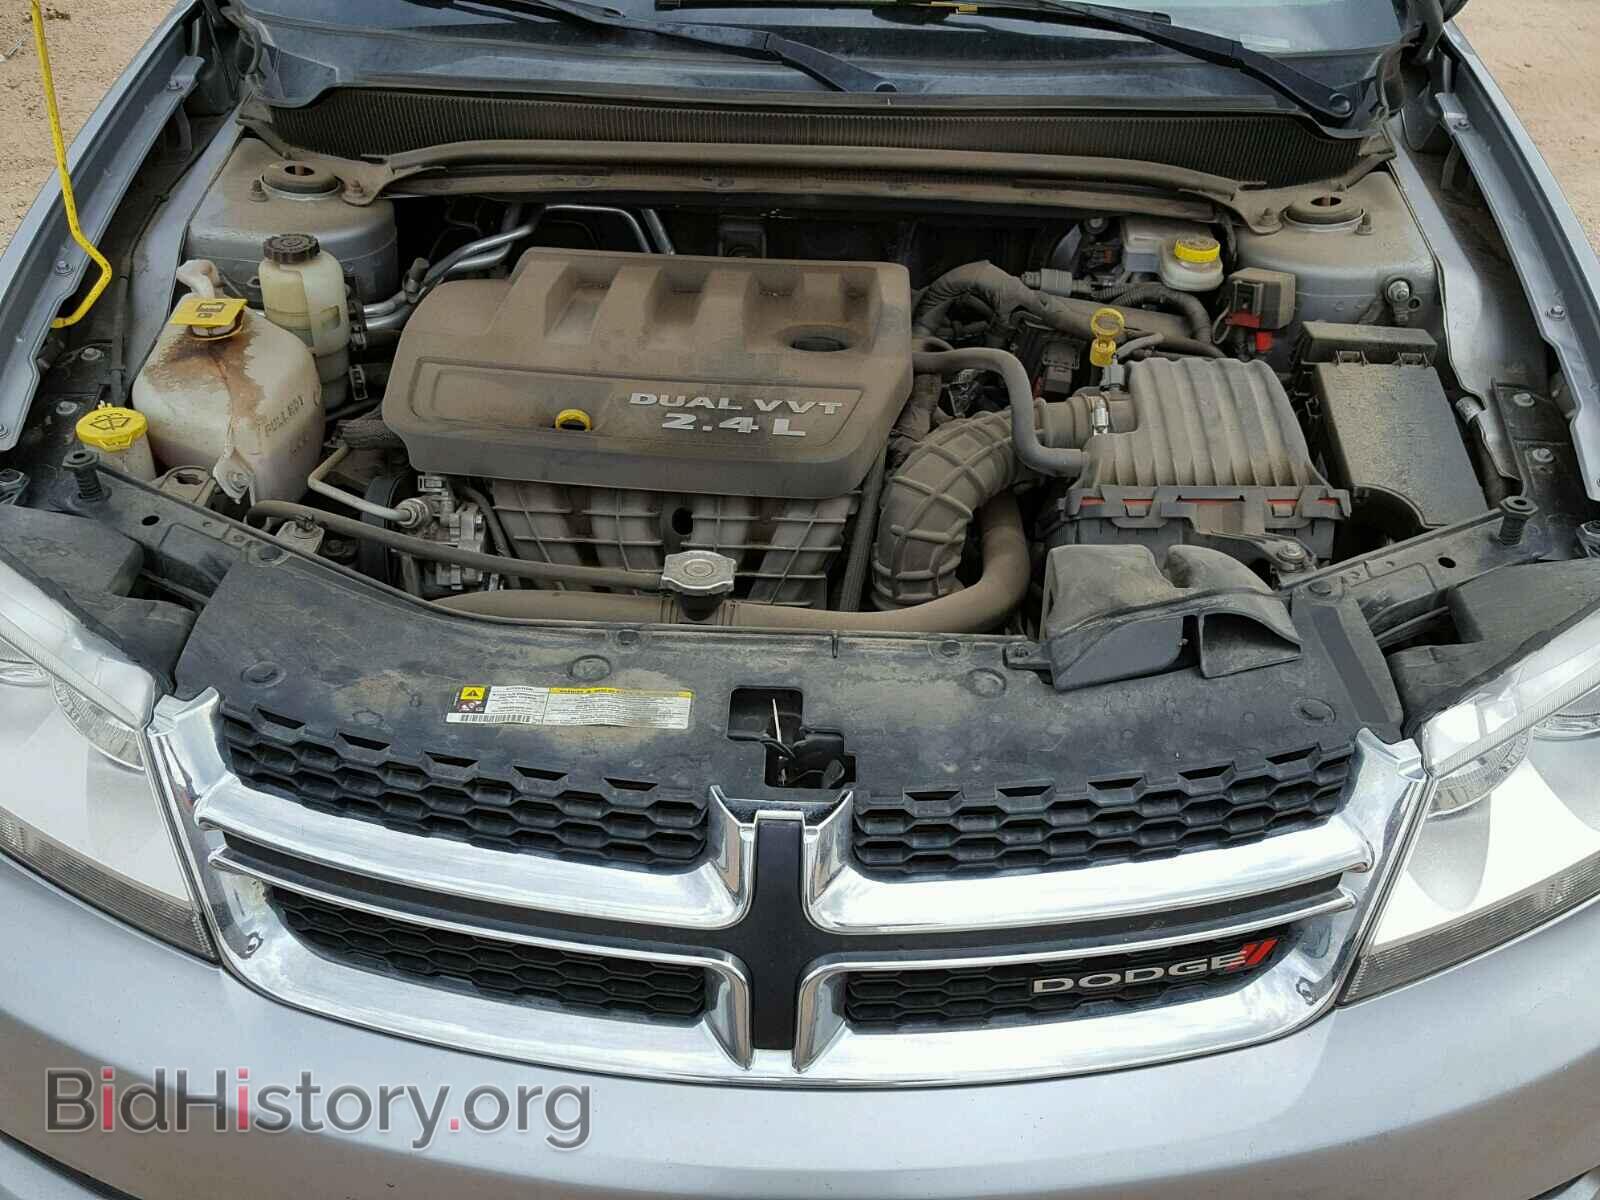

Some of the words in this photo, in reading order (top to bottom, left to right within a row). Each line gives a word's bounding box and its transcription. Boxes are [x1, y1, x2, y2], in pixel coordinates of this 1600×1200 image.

[630, 392, 743, 410] DUAL
[753, 398, 843, 415] VVT
[661, 412, 807, 437] 2.4L
[1032, 950, 1247, 994] DODGE
